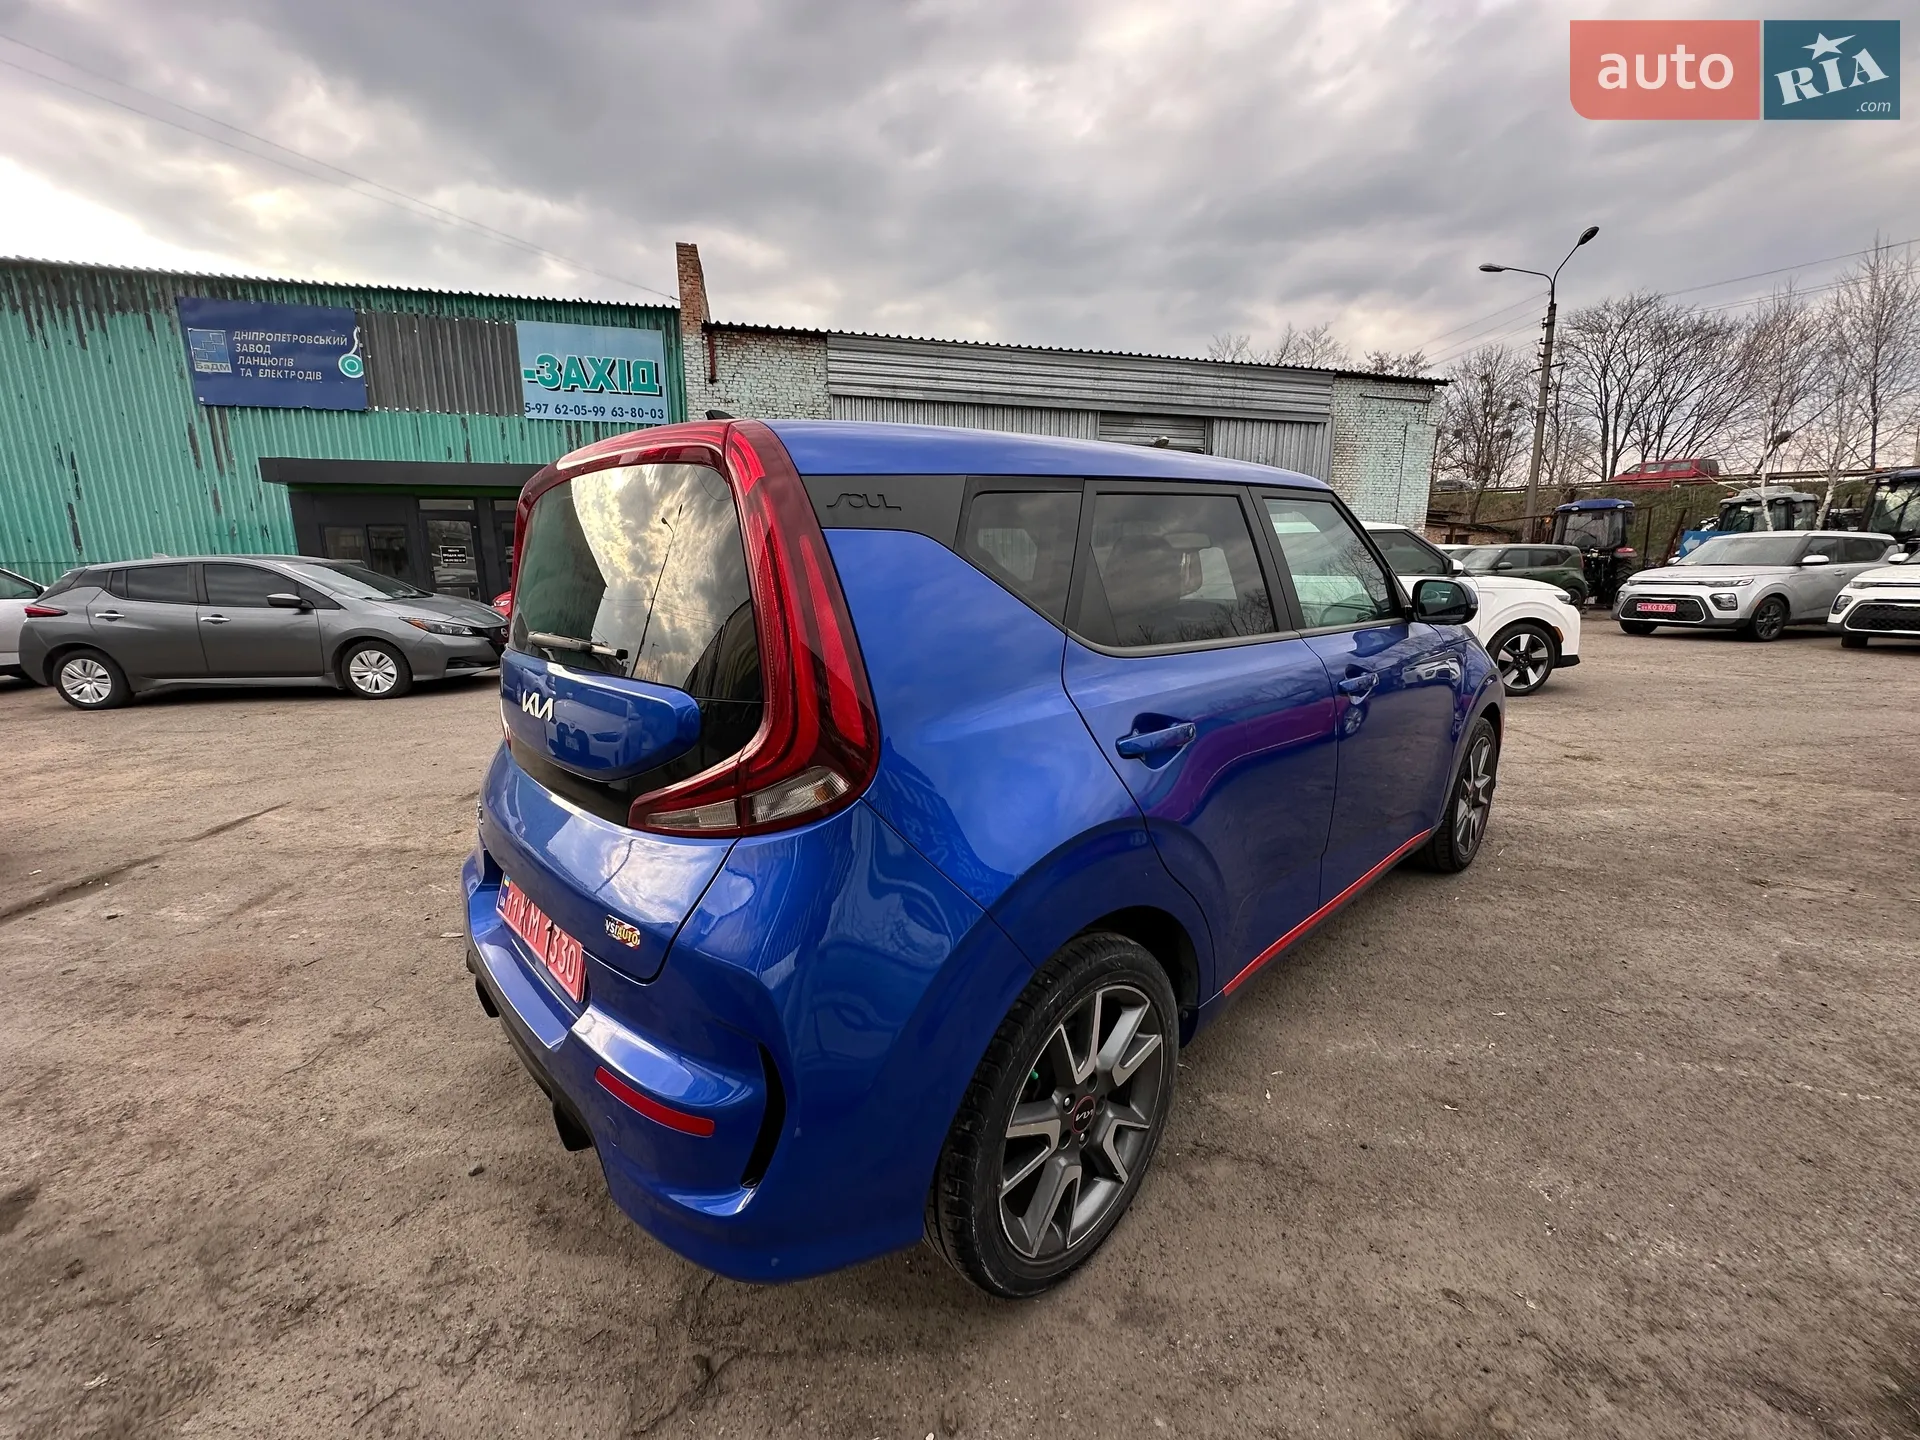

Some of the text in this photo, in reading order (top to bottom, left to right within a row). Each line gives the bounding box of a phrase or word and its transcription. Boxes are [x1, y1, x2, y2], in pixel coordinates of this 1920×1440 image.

[233, 331, 348, 346] ДНІПРОПЕТРОВСЬКИЙ
[234, 343, 272, 355] ЗАВОД
[195, 361, 231, 372] БаДМ
[236, 355, 295, 368] ЛАНЦЮГІВ
[240, 367, 253, 378] ТА
[554, 403, 606, 417] 62-05-99
[611, 405, 665, 420] 63-80-03
[826, 492, 902, 511] SOUL
[522, 689, 554, 722] KIA
